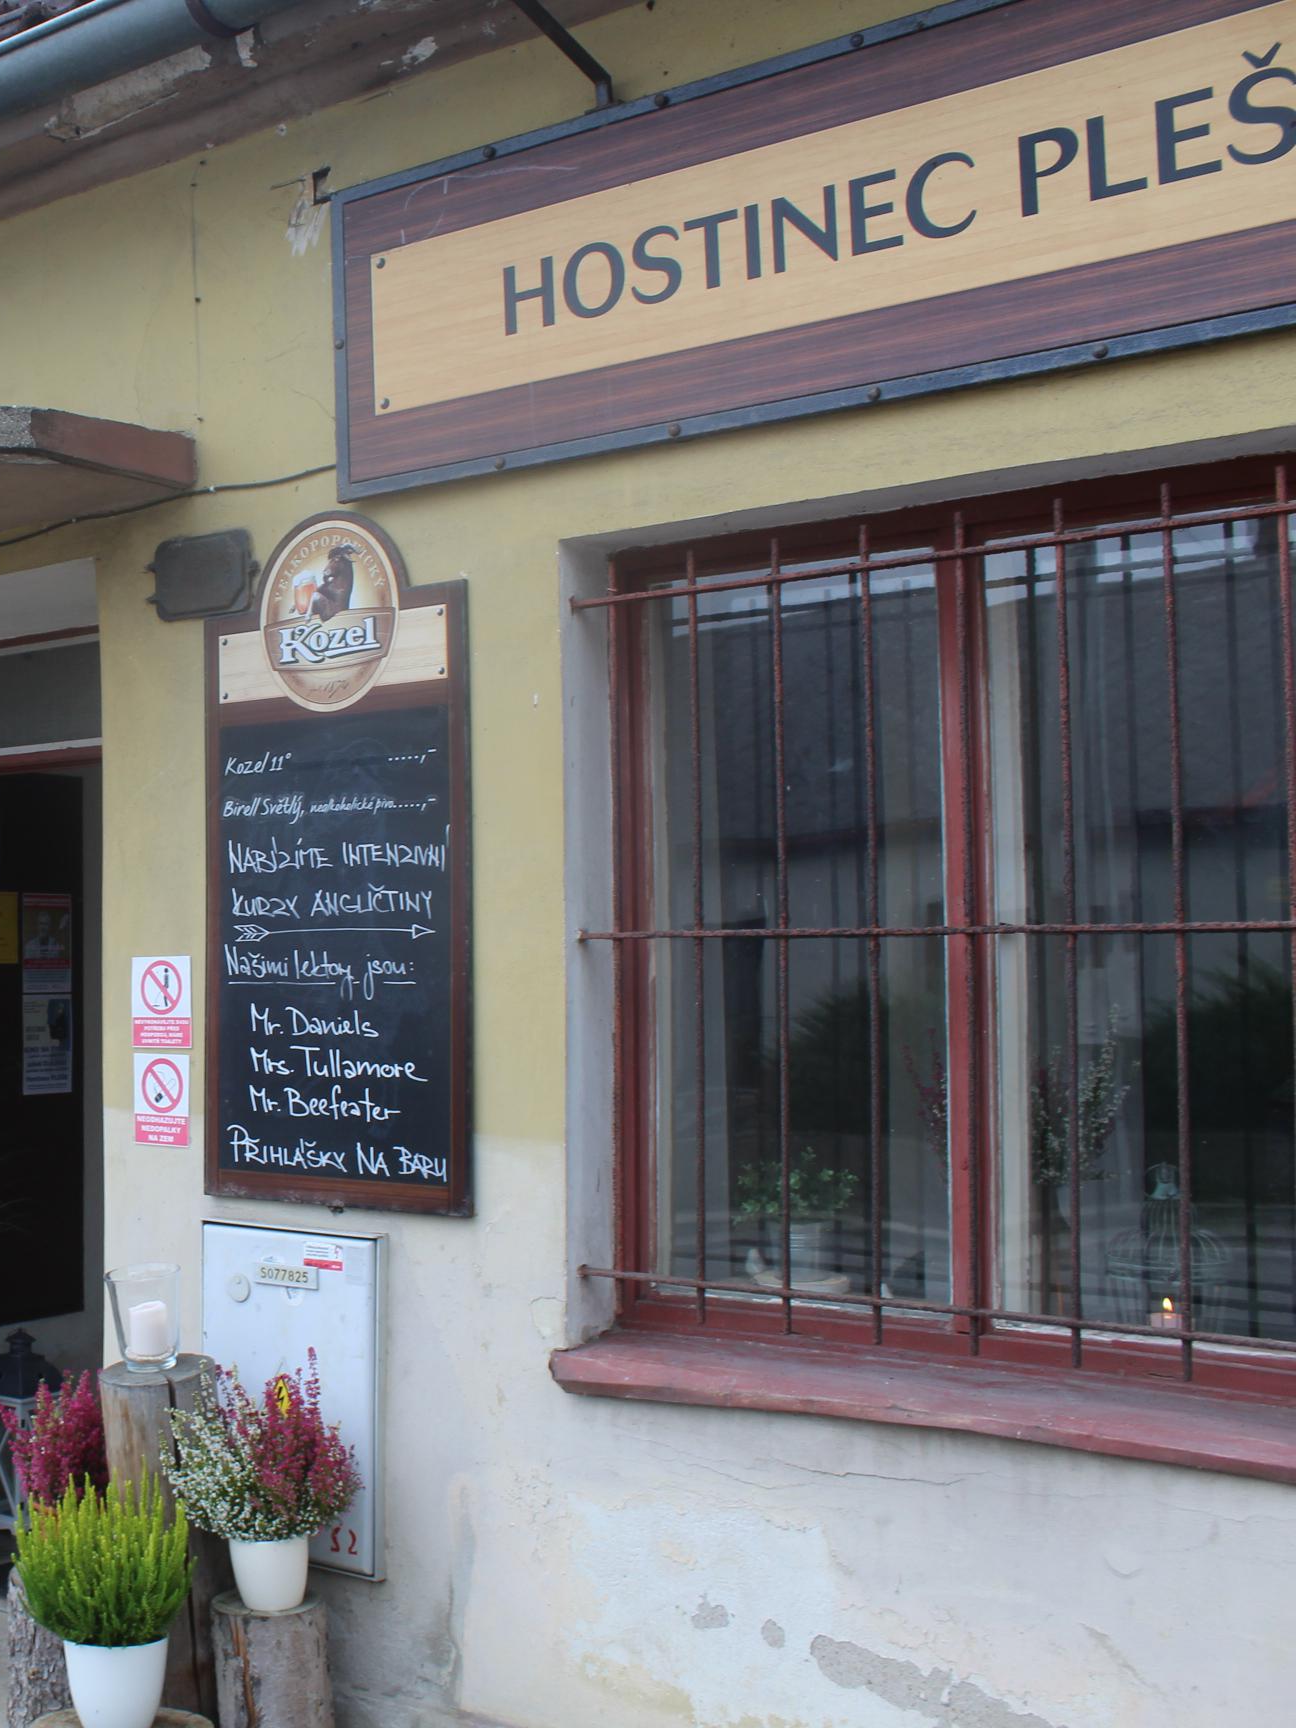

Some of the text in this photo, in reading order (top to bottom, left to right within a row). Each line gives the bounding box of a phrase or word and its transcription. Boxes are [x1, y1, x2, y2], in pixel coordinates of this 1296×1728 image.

[503, 41, 1296, 337] HOSTINEC PLEŠ
[279, 616, 382, 664] Kozel
[225, 751, 271, 776] Kozel
[223, 797, 261, 817] Birell
[228, 824, 451, 873] NABÍZÍME INTENZIVNÍ
[232, 883, 432, 919] KURZY ANGLIČTINY
[225, 944, 289, 979] Našimi
[363, 954, 415, 1000] jsou:
[251, 1003, 379, 1037] Mr. Daniels
[250, 1045, 429, 1081] Mrs. Tullamore
[249, 1085, 401, 1122] Mr. Beefeater
[226, 1124, 448, 1182] PŘIHLÁŠKY NA BARU
[260, 1266, 308, 1283] S077825
